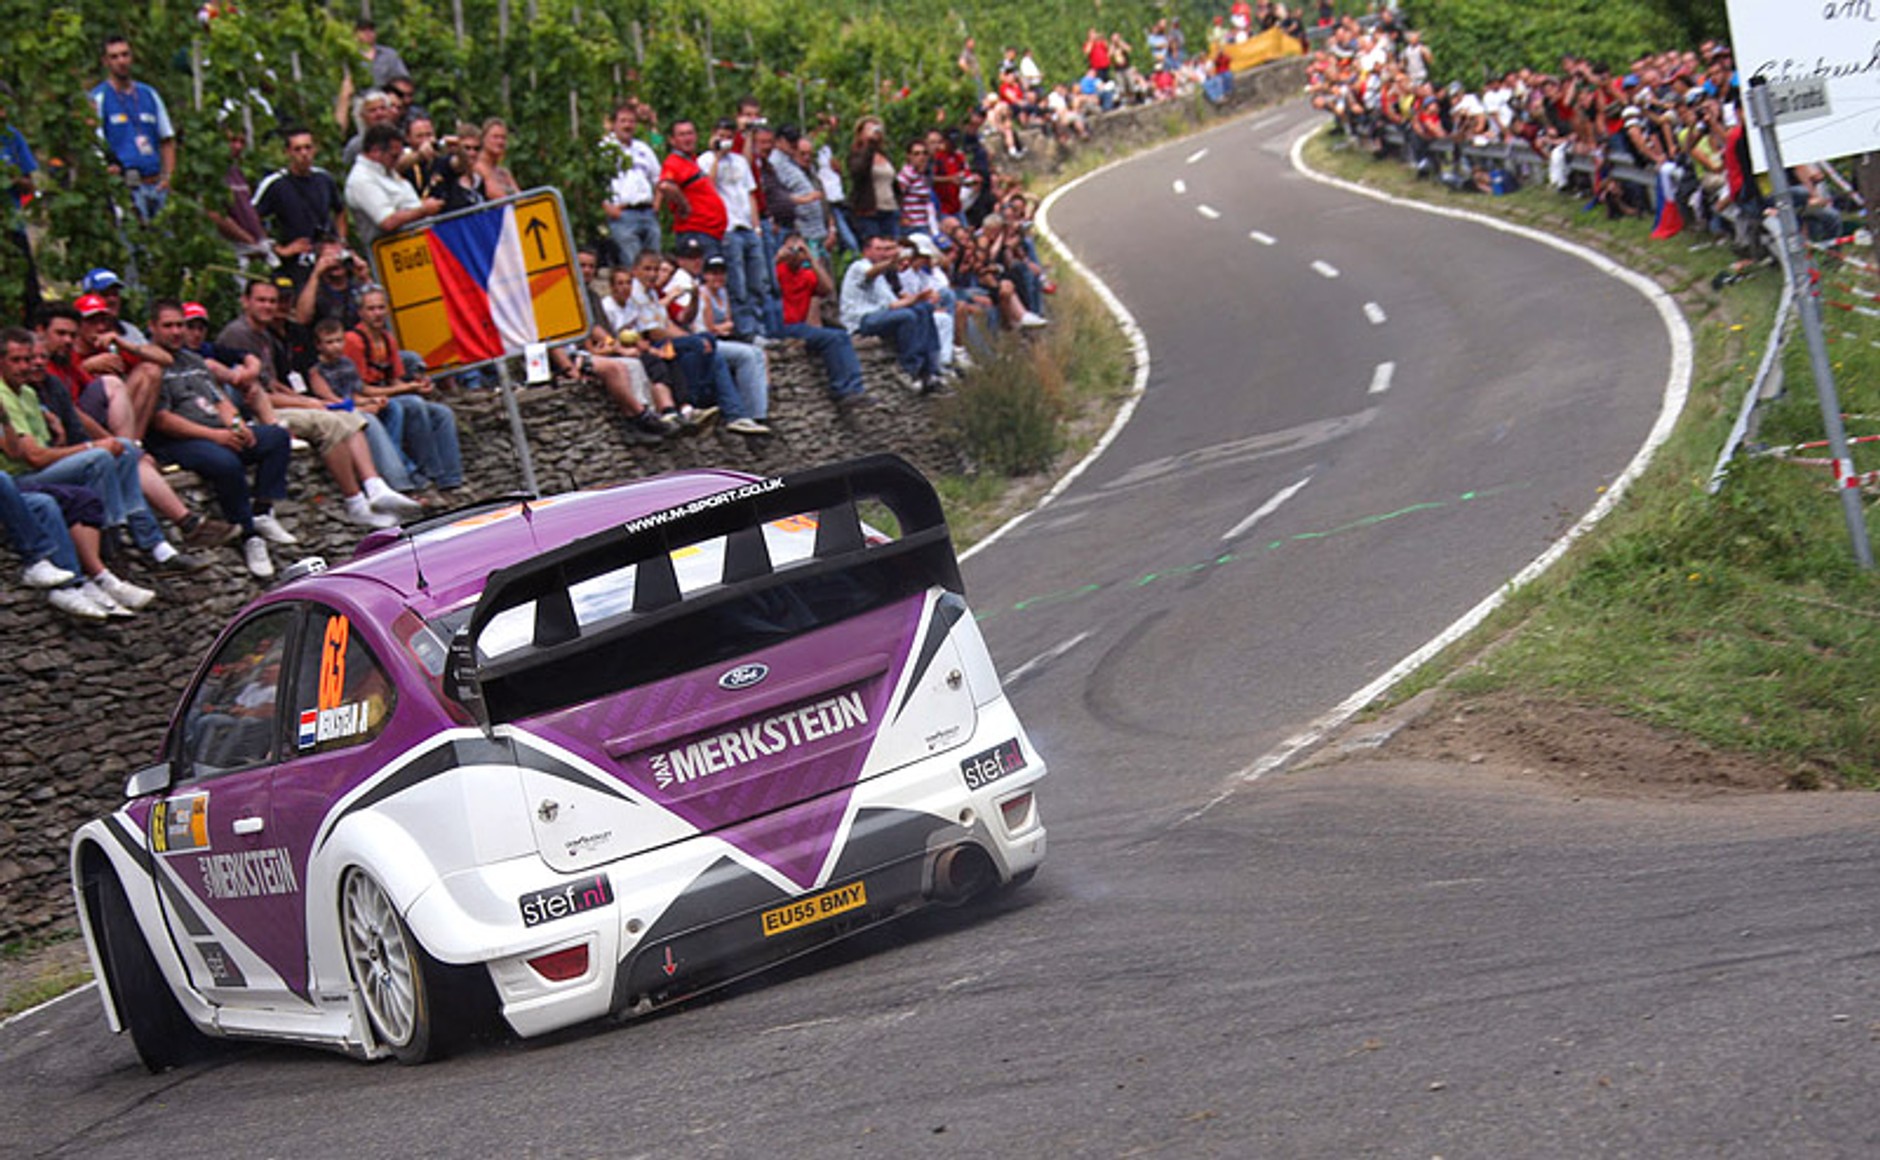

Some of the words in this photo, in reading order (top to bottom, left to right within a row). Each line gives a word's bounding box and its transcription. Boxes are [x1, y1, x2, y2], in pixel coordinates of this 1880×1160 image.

[391, 245, 430, 273] Büdl
[625, 477, 785, 534] WWW.M-SPORT.CO.UK
[318, 614, 350, 711] 63
[649, 753, 674, 790] VAN
[965, 739, 1024, 788] stef.nl
[523, 874, 607, 924] stef.nl
[766, 902, 815, 930] EU55
[820, 885, 861, 912] BMY
